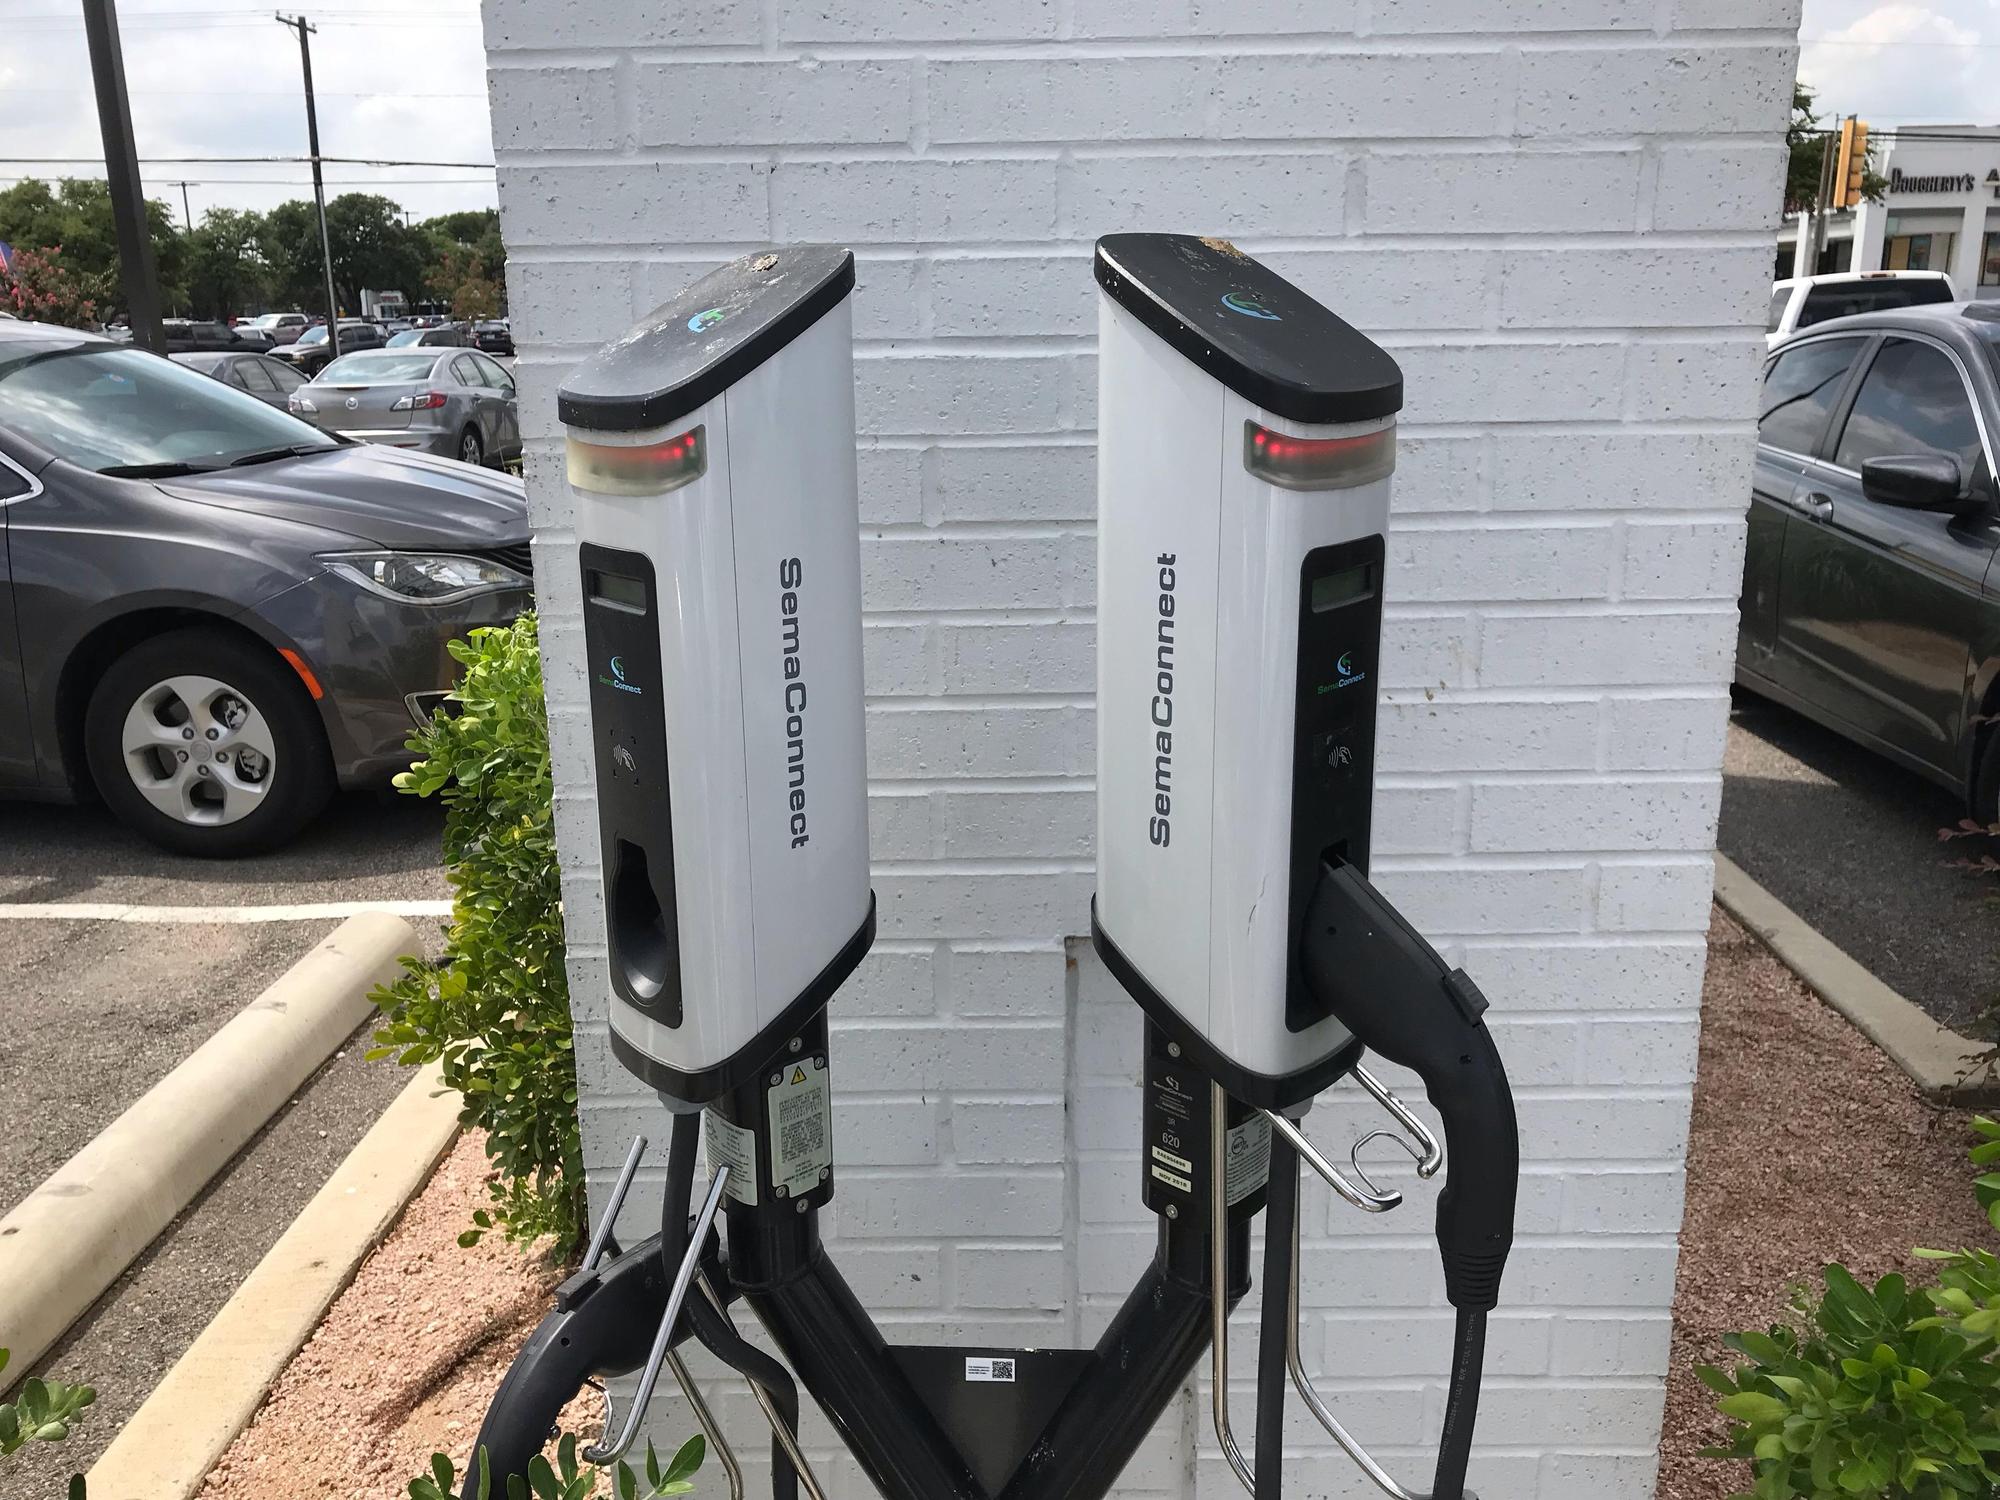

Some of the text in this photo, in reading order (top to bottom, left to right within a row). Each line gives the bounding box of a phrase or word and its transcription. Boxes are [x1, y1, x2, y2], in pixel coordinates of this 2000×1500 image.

[780, 557, 809, 849] SemaConnect
[1150, 553, 1176, 848] SemaConnect
[1317, 672, 1366, 694] SemaConnect
[1162, 1132, 1180, 1148] 620
